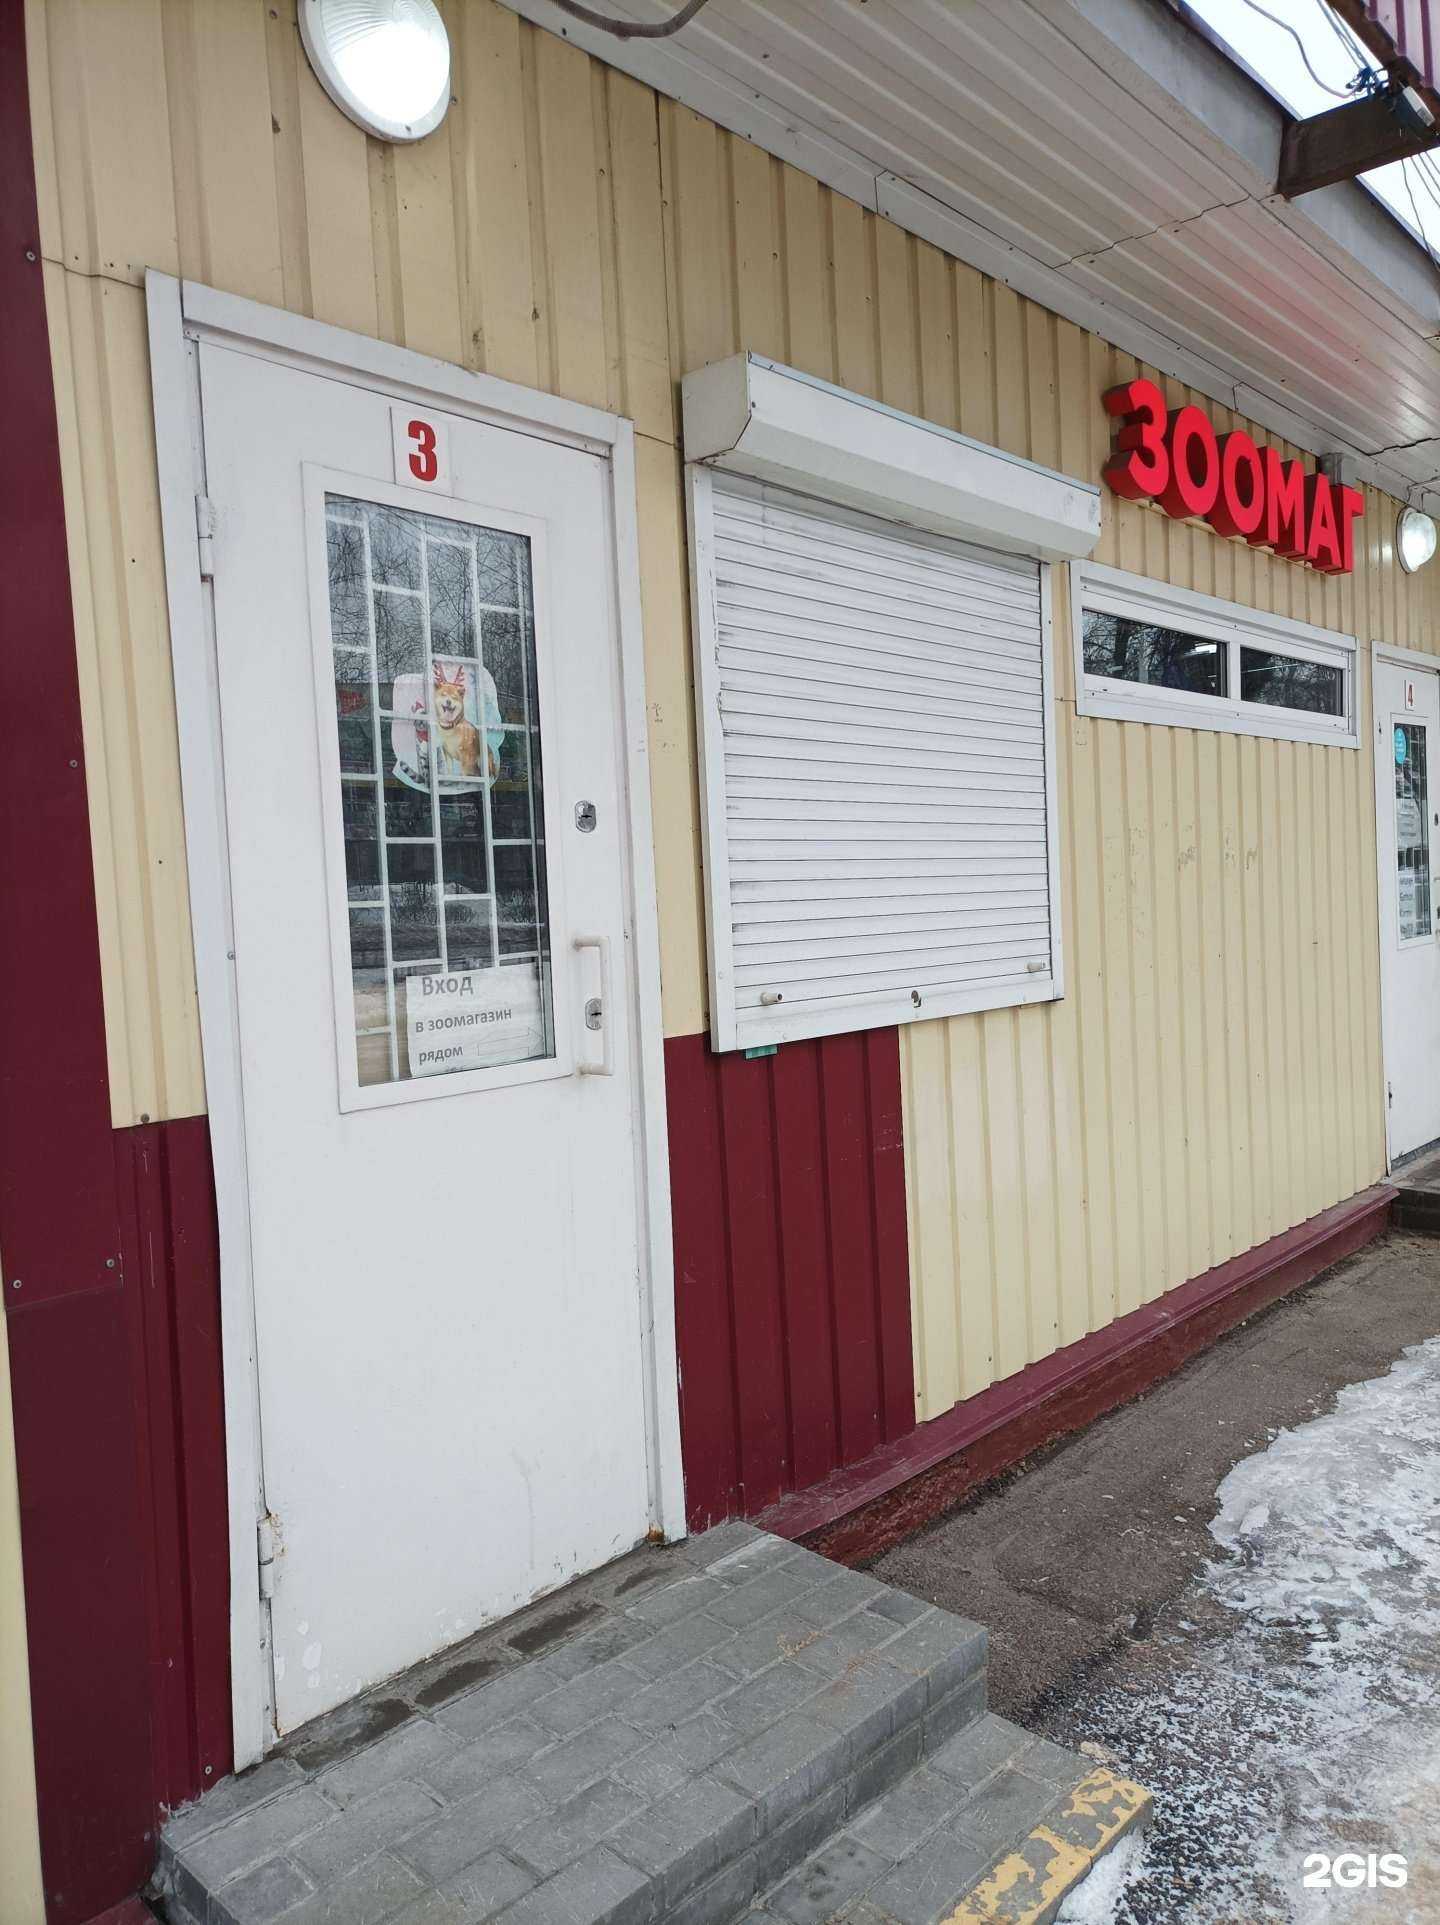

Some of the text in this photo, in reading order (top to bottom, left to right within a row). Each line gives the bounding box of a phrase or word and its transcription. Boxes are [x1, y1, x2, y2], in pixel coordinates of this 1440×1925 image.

[408, 420, 438, 481] 3
[1105, 378, 1364, 575] ЗООМАГ
[1407, 684, 1414, 706] 4
[422, 976, 473, 996] Вход
[416, 1009, 512, 1033] в зоомагазин
[419, 1046, 463, 1065] рядом
